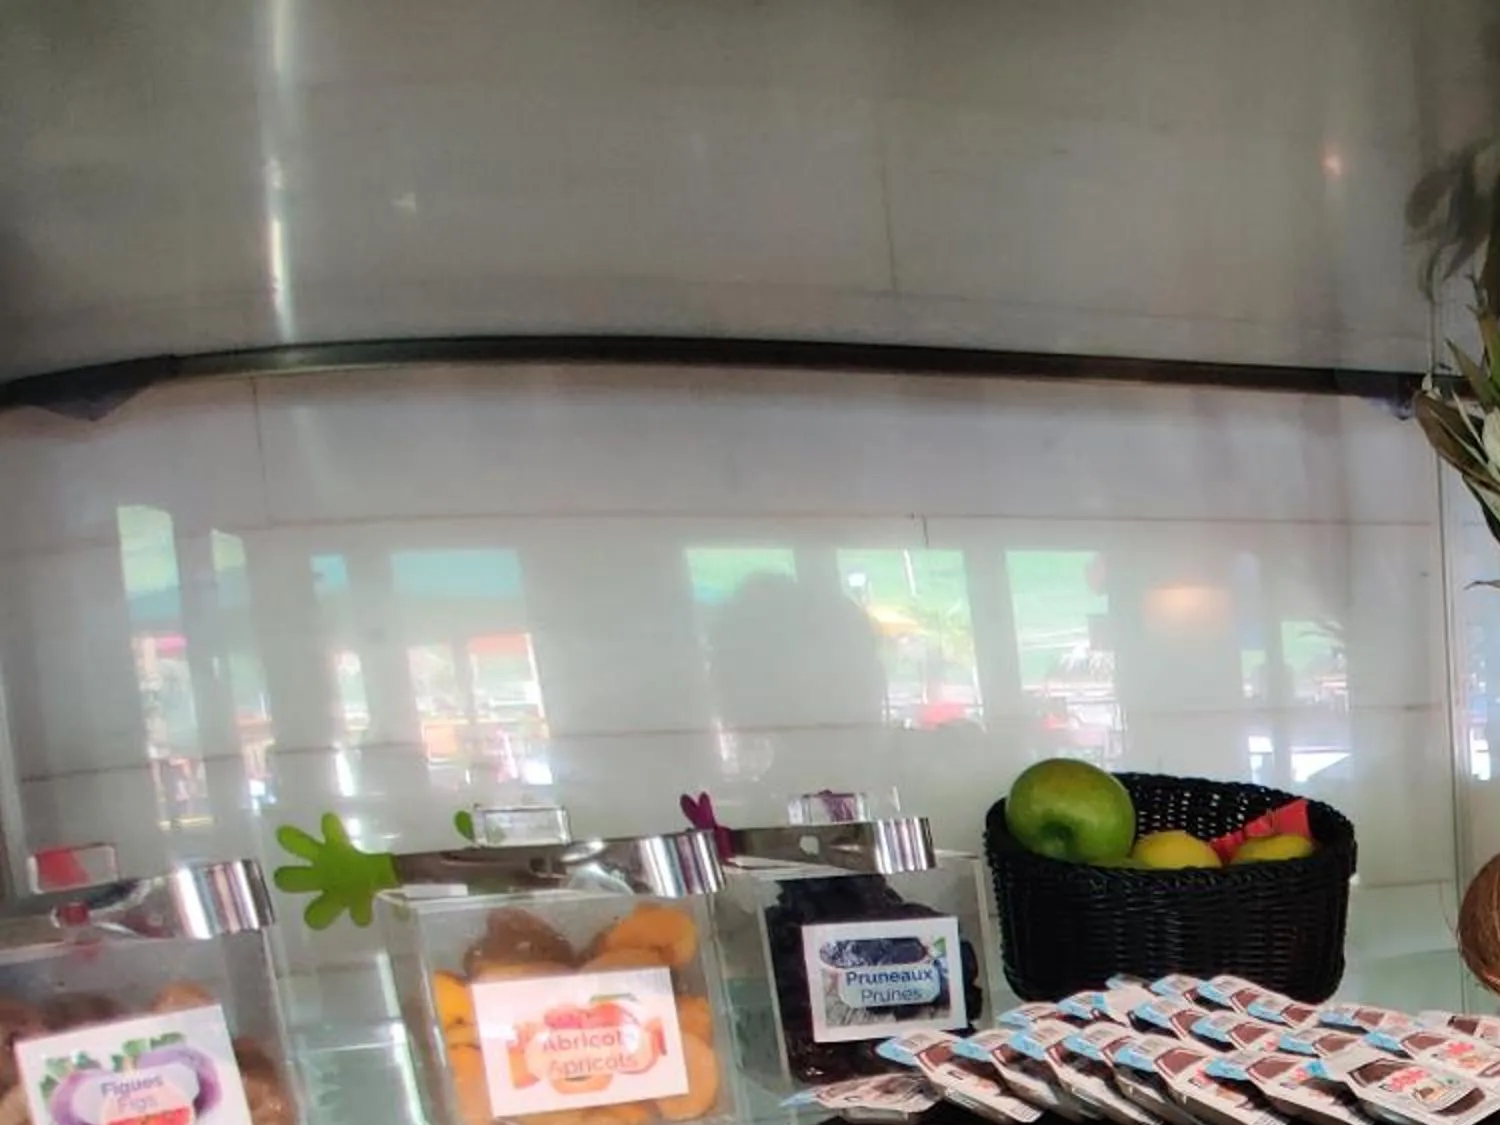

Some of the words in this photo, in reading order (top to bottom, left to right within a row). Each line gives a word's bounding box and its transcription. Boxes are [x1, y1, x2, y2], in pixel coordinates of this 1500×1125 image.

[845, 966, 934, 986] Pruneaux
[861, 987, 922, 1003] Prunes
[543, 1028, 634, 1053] Abricot
[101, 1075, 164, 1098] Figues
